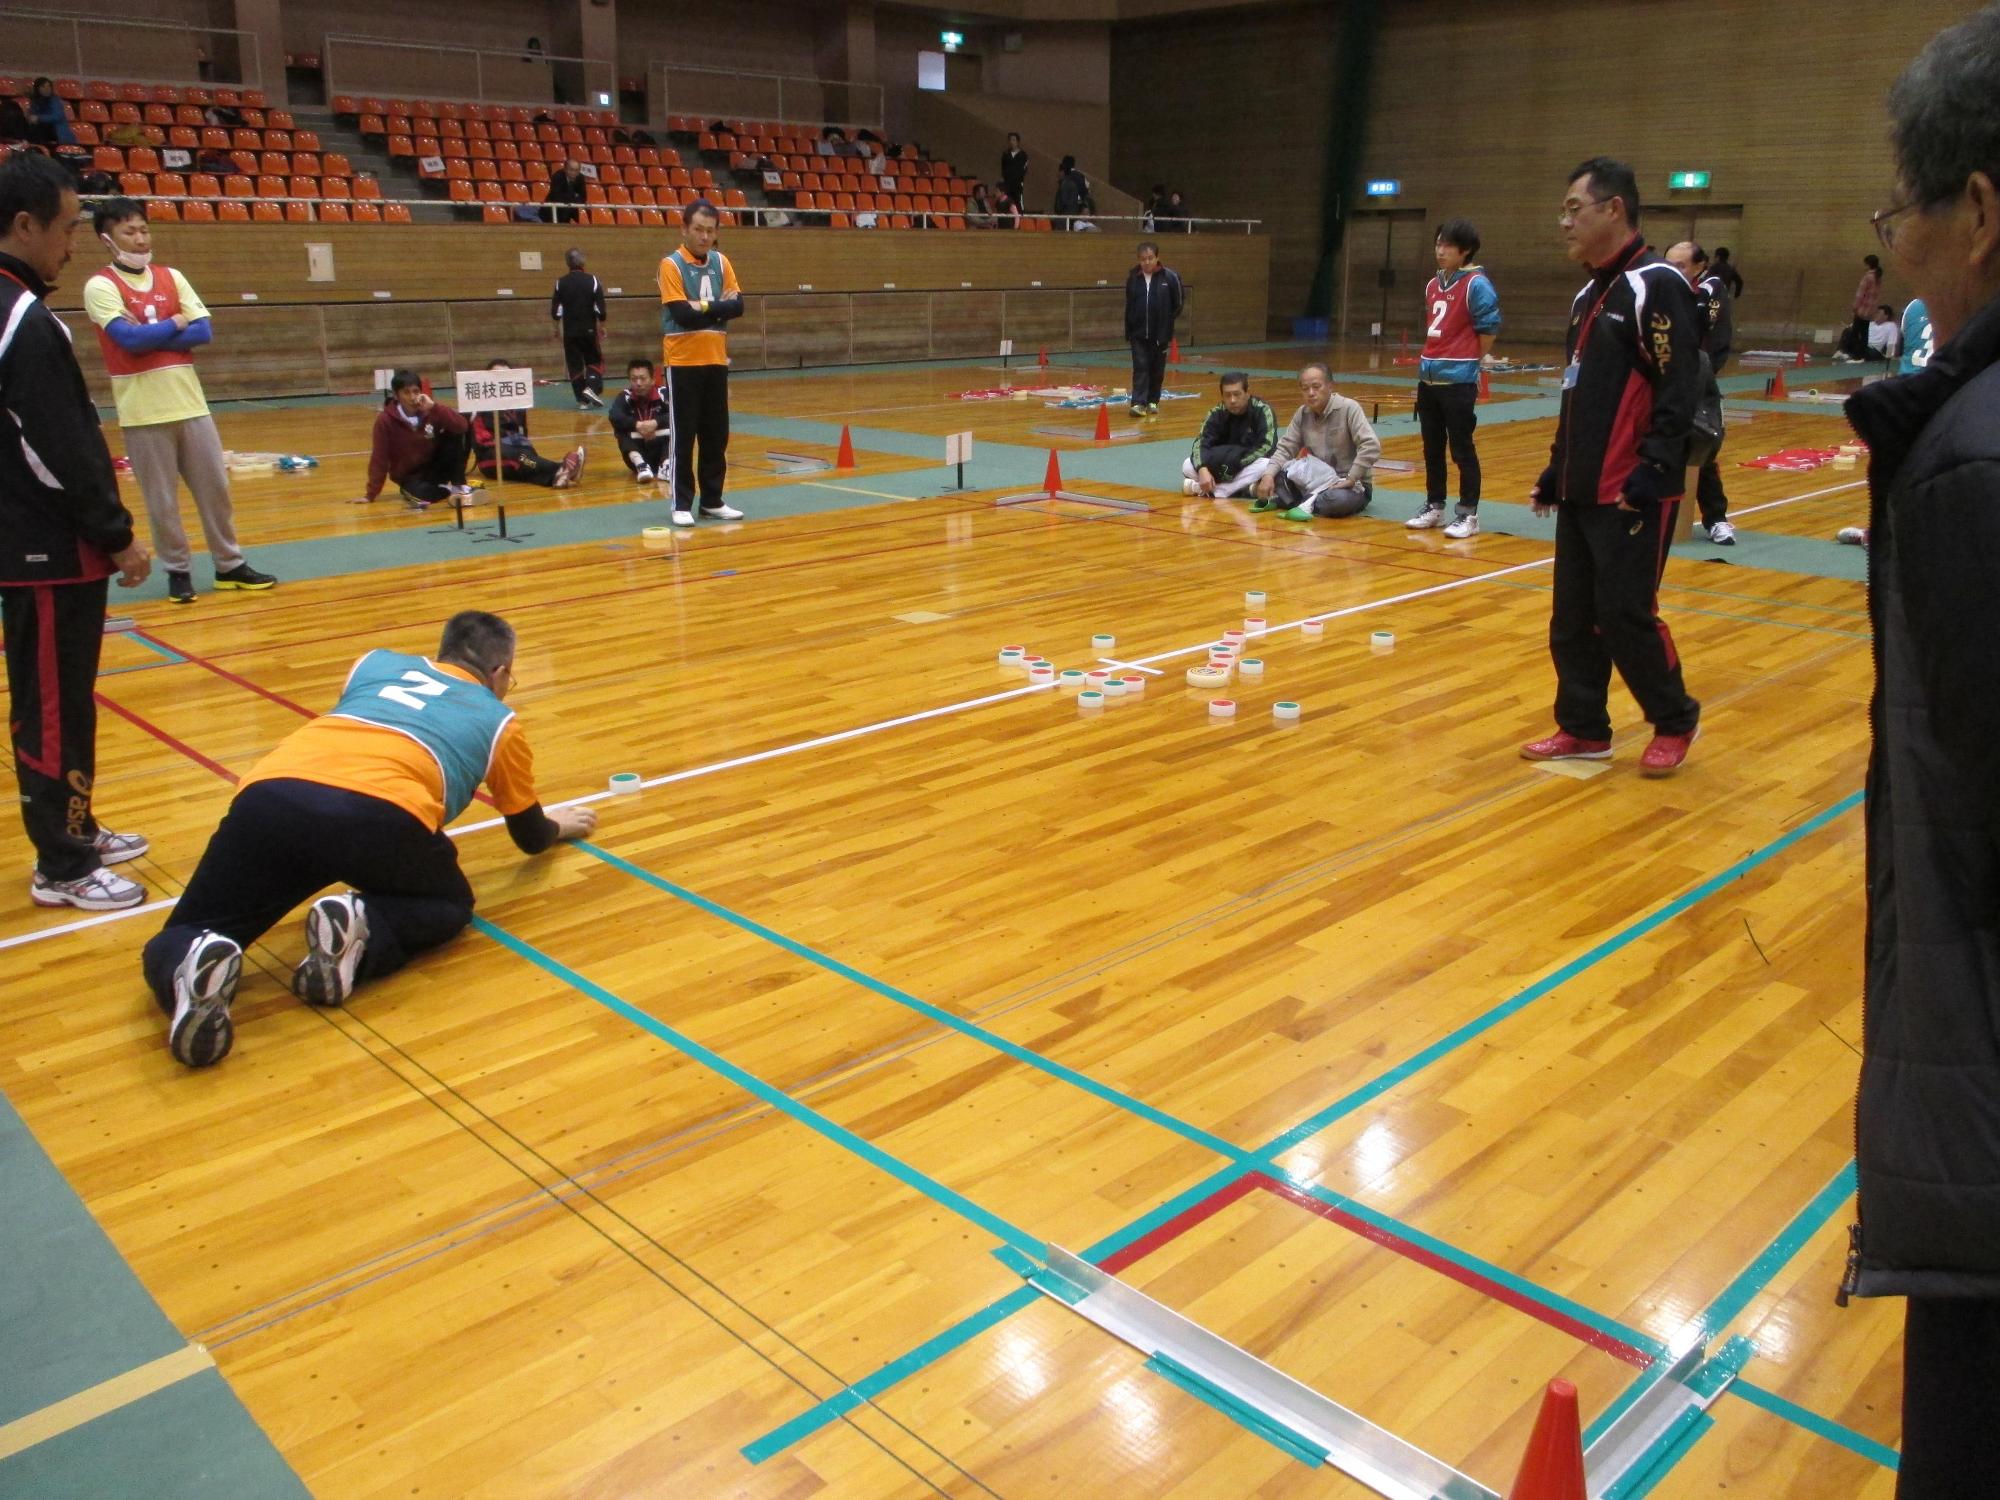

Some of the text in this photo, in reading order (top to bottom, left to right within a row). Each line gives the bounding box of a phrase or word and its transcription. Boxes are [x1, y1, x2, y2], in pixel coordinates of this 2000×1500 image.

[1427, 300, 1448, 337] 2
[1912, 323, 1934, 367] 3
[465, 380, 527, 400] 稲枝西B
[377, 670, 450, 710] 2
